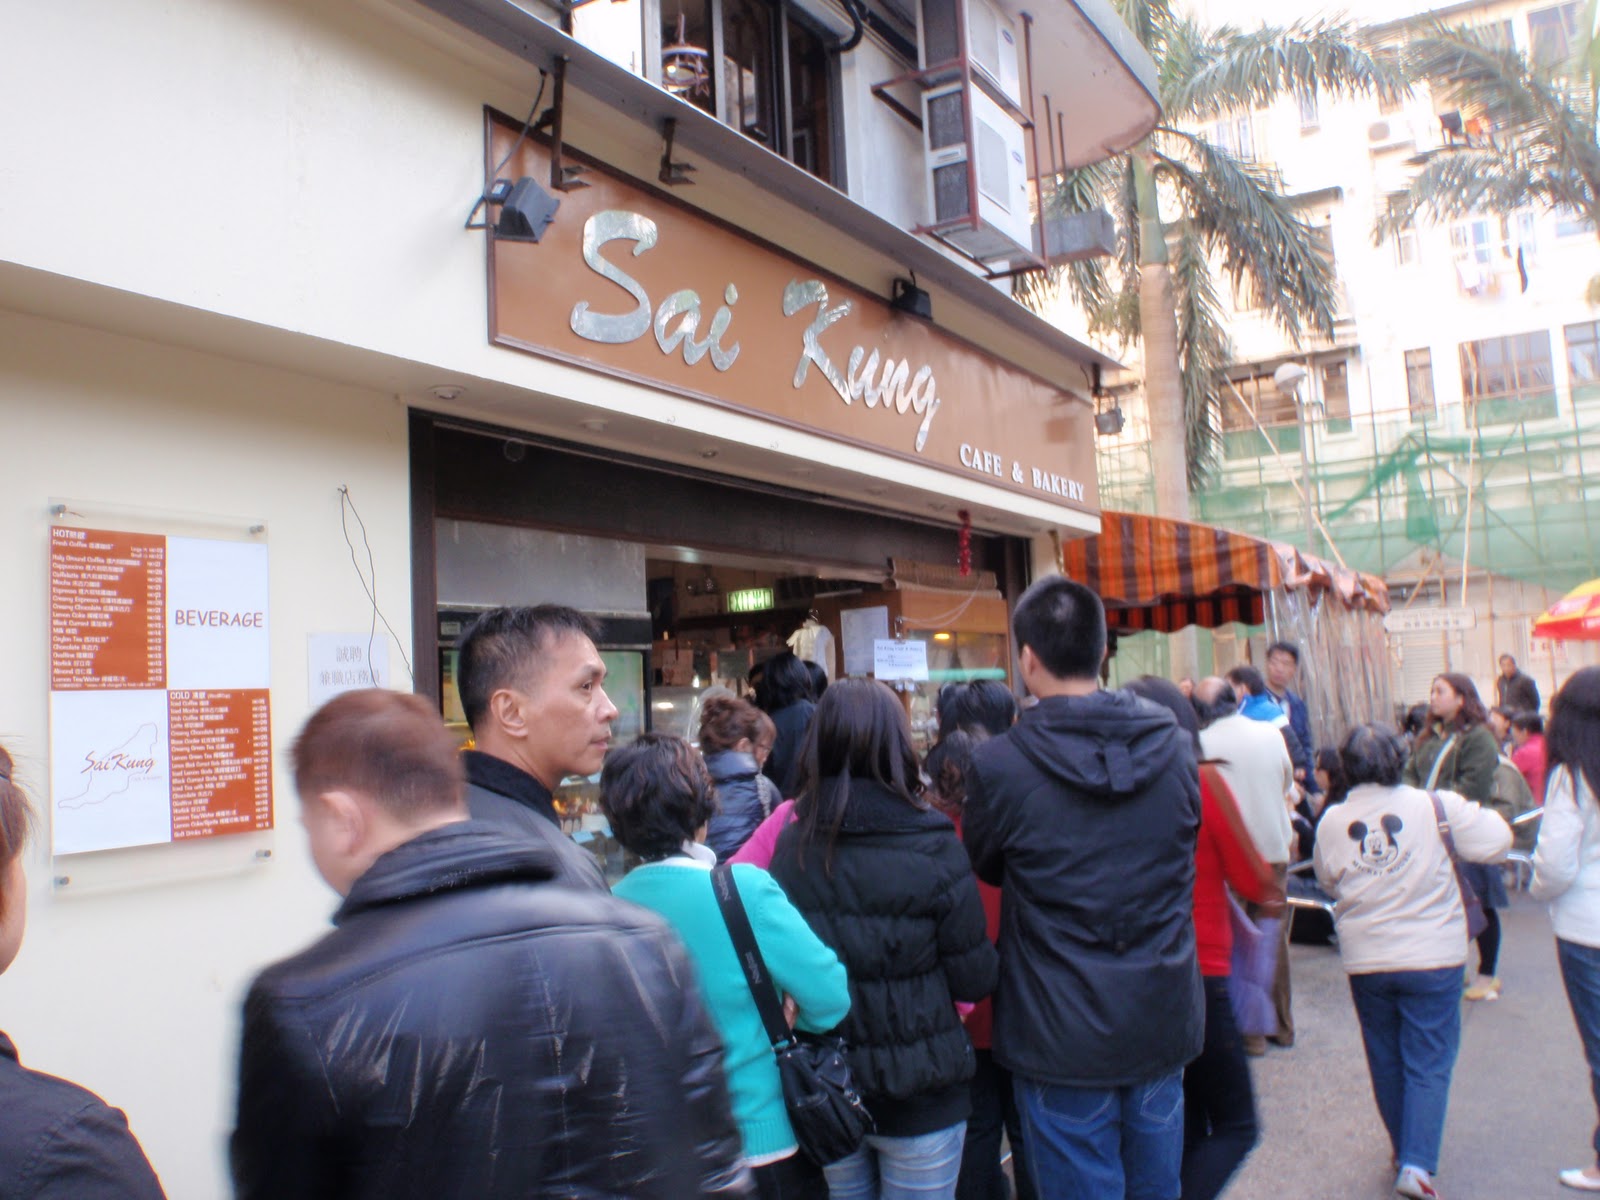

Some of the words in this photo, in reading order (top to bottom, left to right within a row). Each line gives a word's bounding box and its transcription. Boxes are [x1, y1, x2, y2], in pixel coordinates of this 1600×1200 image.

[570, 210, 741, 372] Sai
[783, 279, 940, 452] Kung
[959, 443, 1003, 477] CAFE
[1012, 462, 1024, 484] &
[1032, 467, 1085, 503] BAKERY
[728, 591, 750, 612] EXIT
[175, 610, 263, 628] BEVERAGE
[81, 751, 110, 774] Sai
[110, 753, 154, 774] Kung
